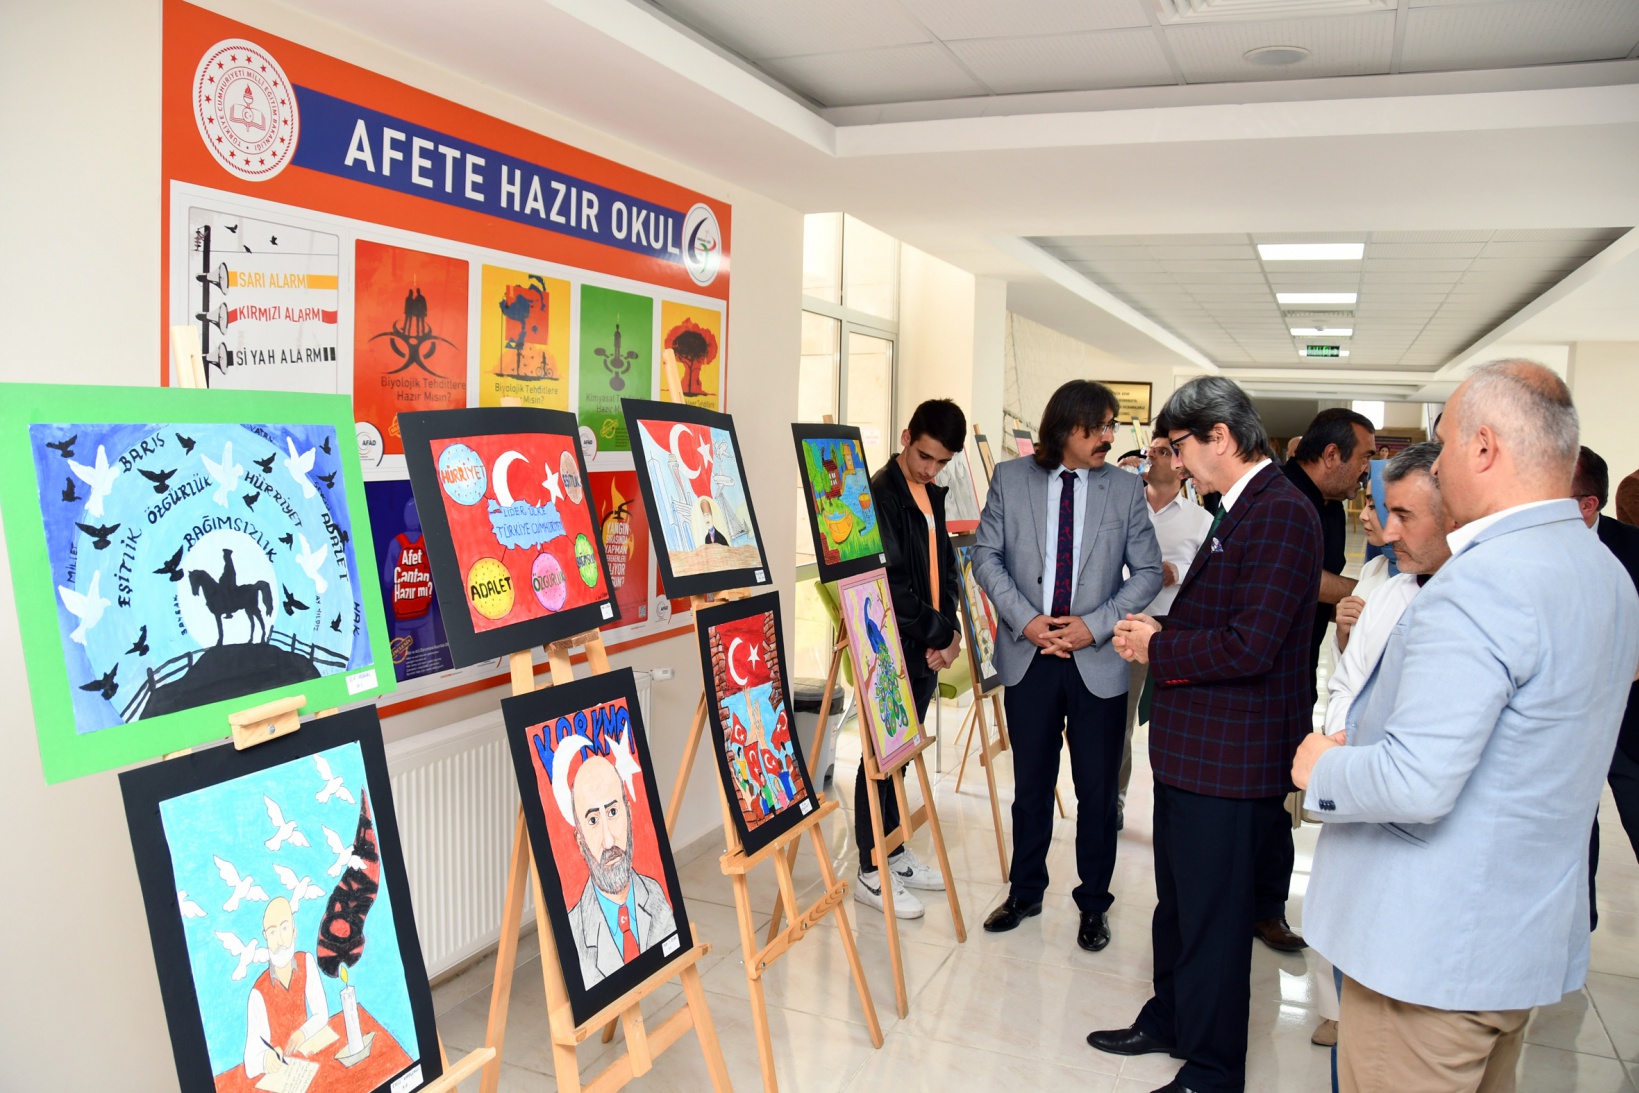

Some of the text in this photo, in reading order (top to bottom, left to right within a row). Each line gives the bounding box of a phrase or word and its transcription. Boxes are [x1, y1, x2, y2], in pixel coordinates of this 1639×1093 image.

[344, 118, 680, 255] AFETE HAZIR OKUL
[238, 271, 308, 289] SARI ALARM
[238, 305, 321, 323] KIRMIZI ALARM
[280, 347, 322, 364] ALARM
[381, 376, 467, 390] Biyolojik Tehditlere
[494, 383, 559, 395] Biyolojik Tehditlere
[397, 390, 452, 402] Hazır Mısın?
[586, 393, 615, 403] Kimyasal
[249, 424, 274, 443] VATAN
[440, 461, 486, 485] HÜRRİYET
[144, 473, 213, 524] ÖZGÜRLÜK
[244, 470, 303, 528] HÜRRİYET
[496, 522, 531, 539] TÜRKİYE
[607, 522, 630, 535] YANGIN
[183, 515, 277, 563] BAĞIMSIZLIK
[401, 549, 423, 565] Afet
[604, 544, 628, 554] YAPMAN
[114, 527, 143, 608] EŞİTLİK
[394, 582, 433, 602] Hazır mı?
[470, 576, 512, 602] ADALET
[353, 601, 361, 637] HAK
